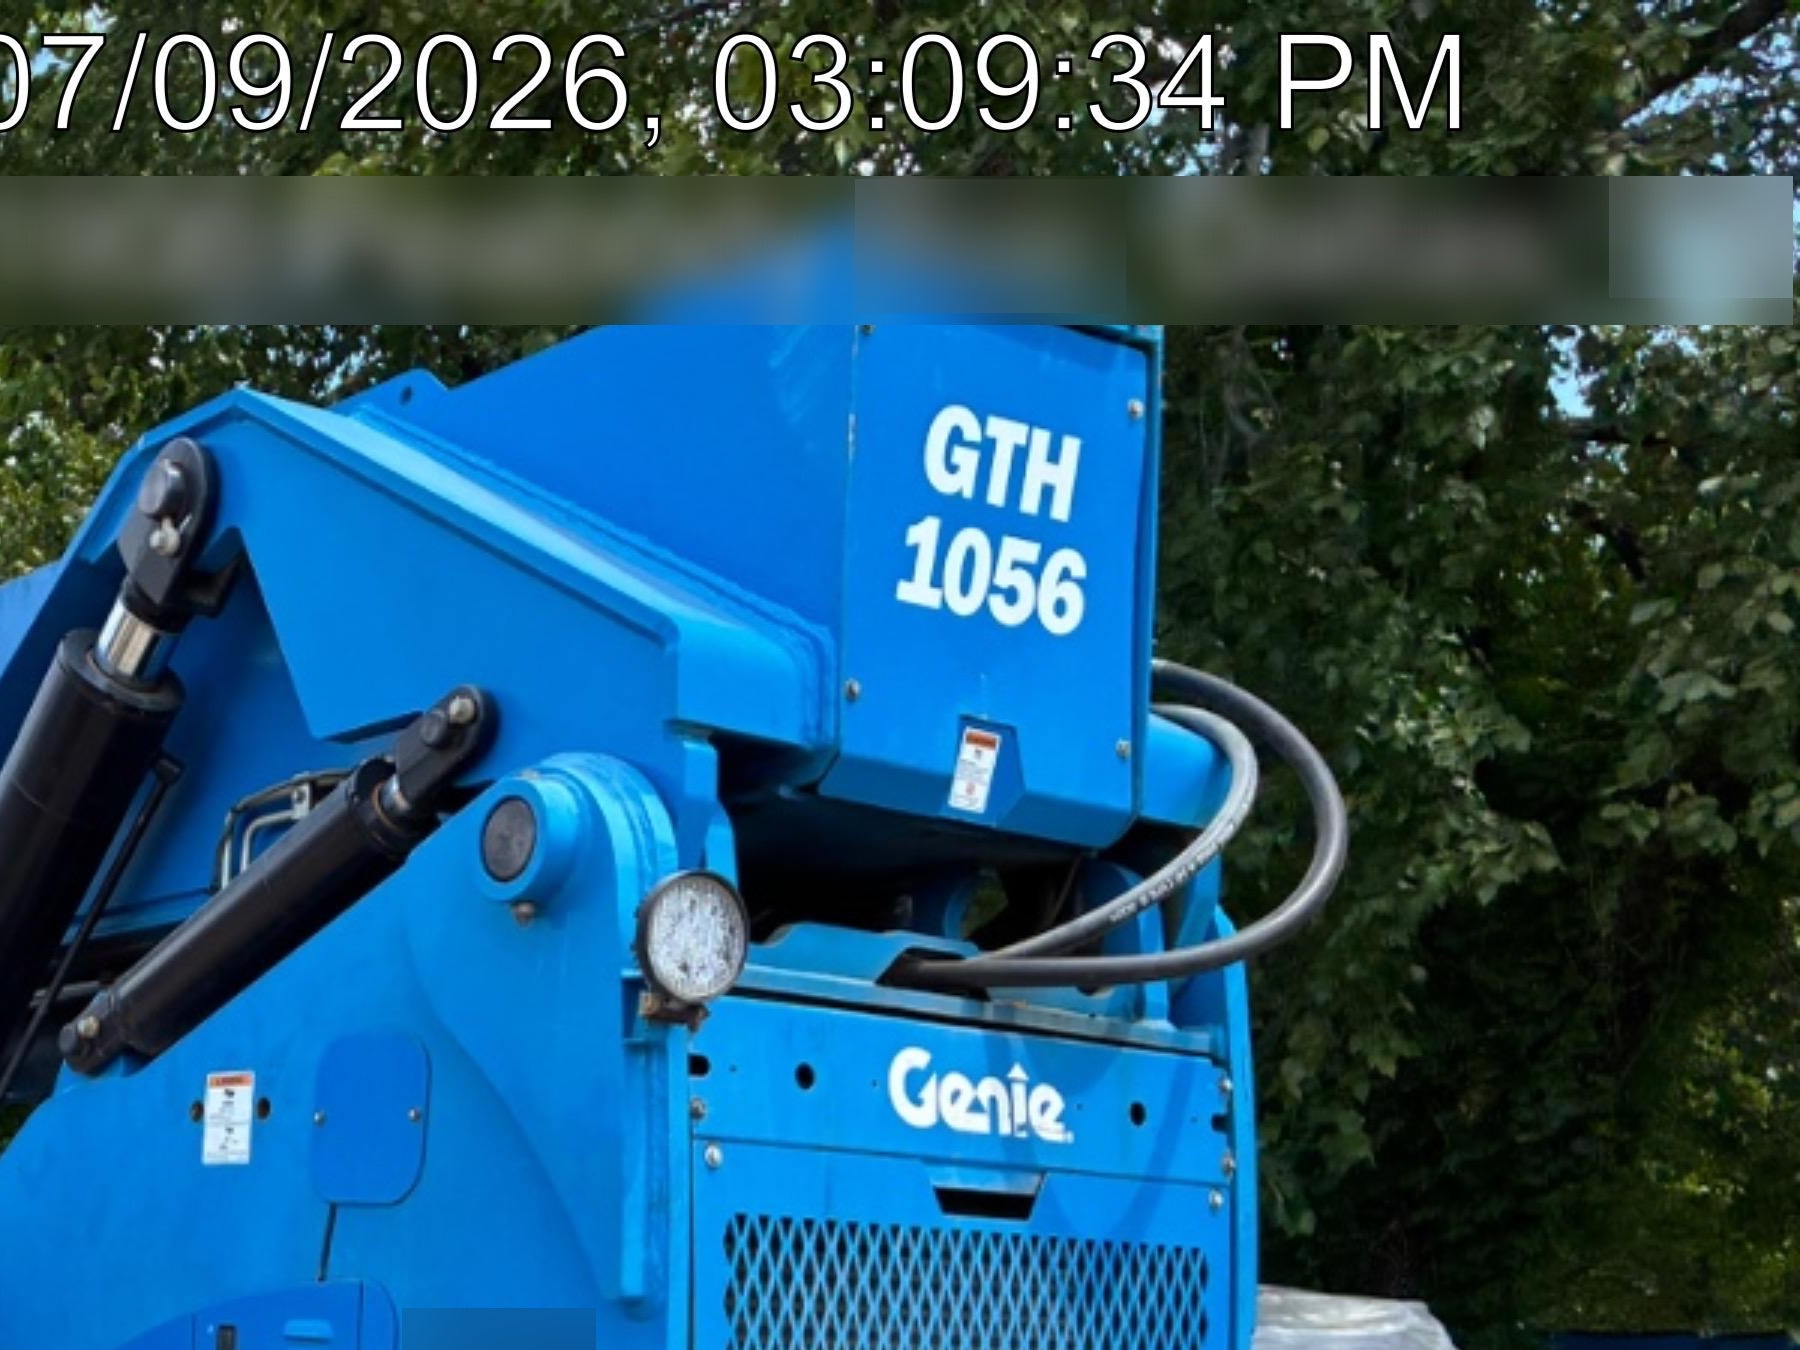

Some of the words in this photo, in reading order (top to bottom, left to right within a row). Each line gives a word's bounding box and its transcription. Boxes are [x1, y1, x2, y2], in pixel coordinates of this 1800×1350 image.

[923, 403, 1082, 523] GTH
[896, 515, 1088, 636] 1056
[888, 1046, 1070, 1144] Genie
